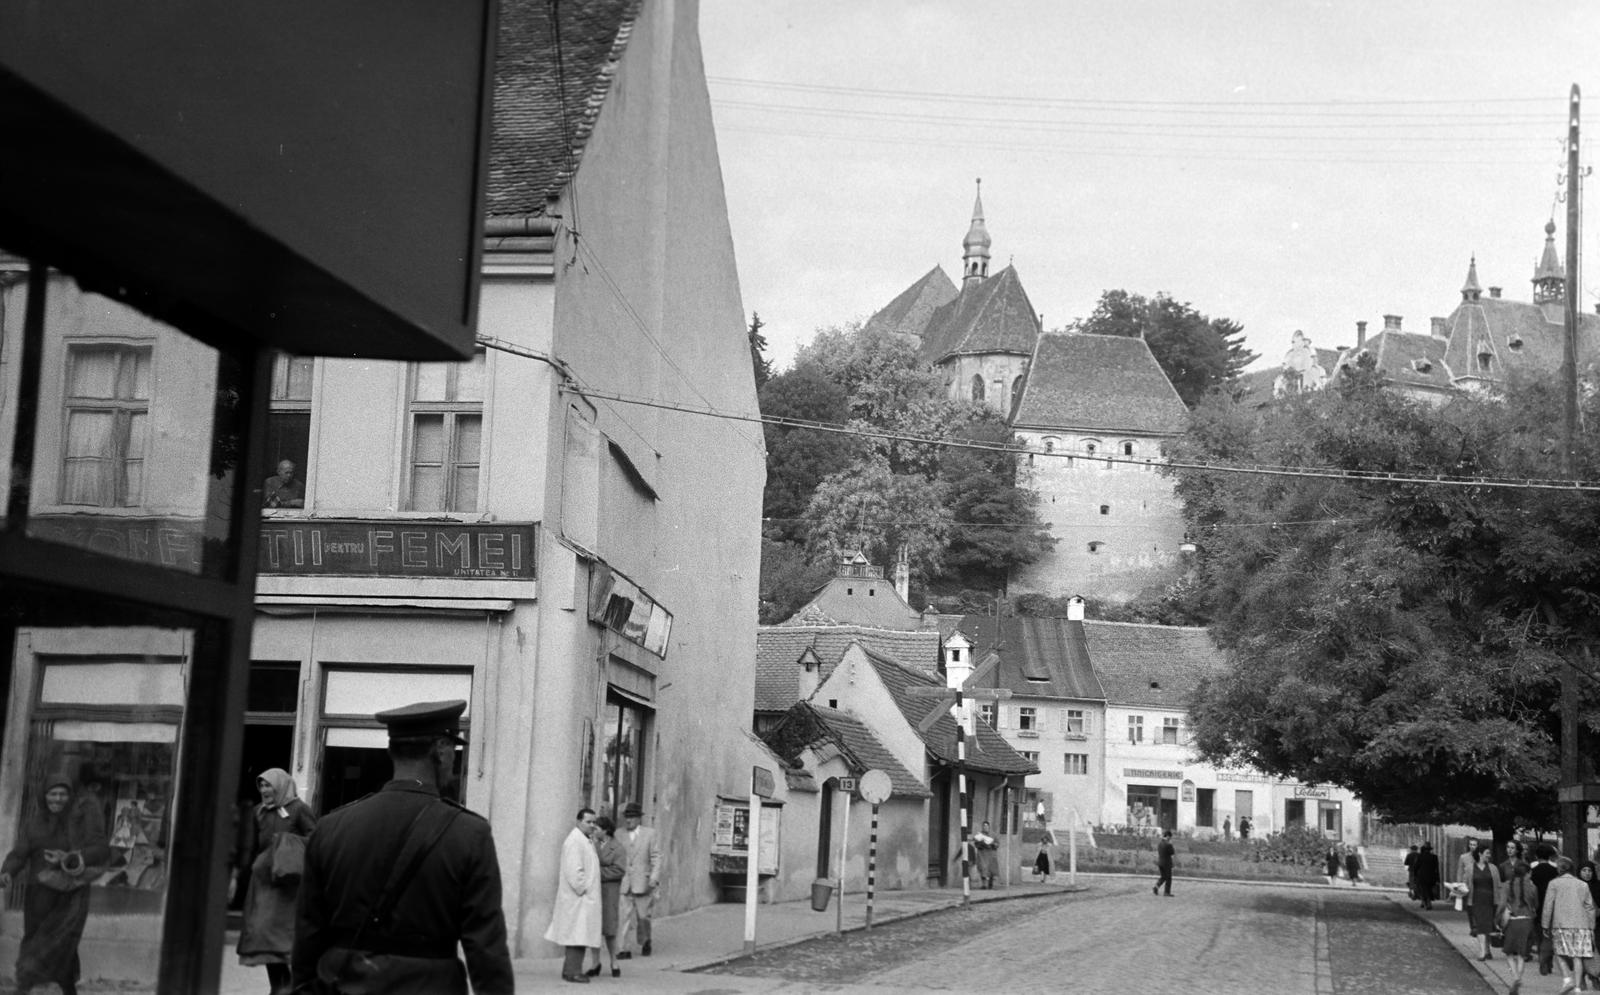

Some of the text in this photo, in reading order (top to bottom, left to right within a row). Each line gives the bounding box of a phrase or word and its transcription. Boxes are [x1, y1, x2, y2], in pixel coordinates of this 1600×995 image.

[324, 542, 364, 553] PENTRU
[368, 530, 522, 569] FEMEI
[843, 780, 853, 790] 13
